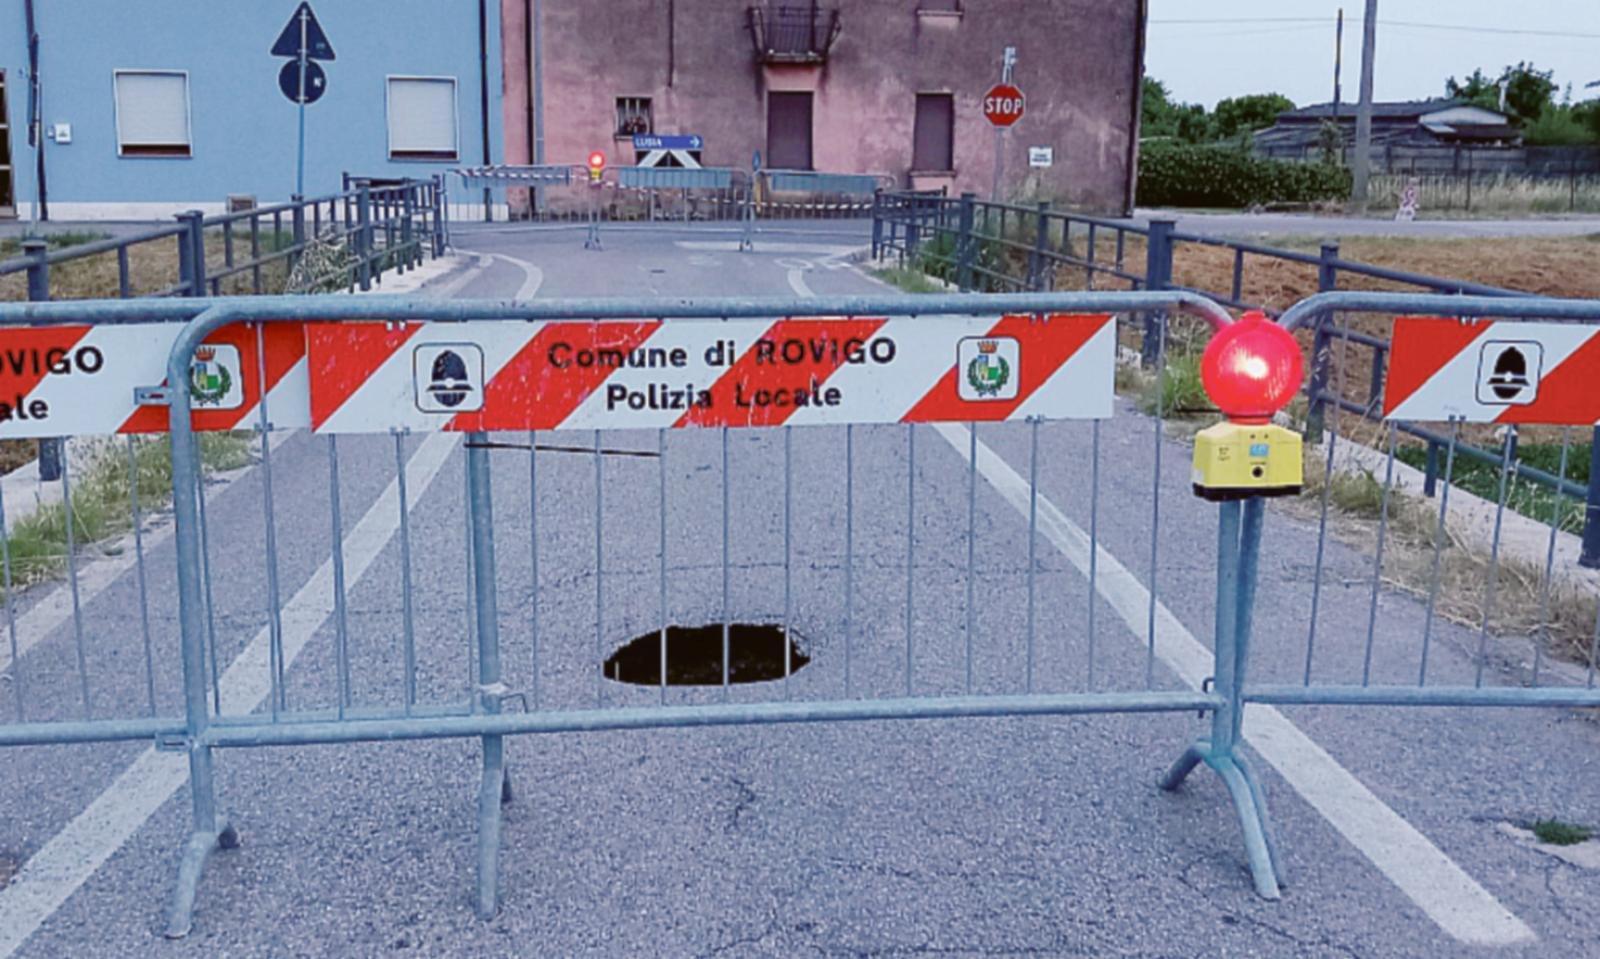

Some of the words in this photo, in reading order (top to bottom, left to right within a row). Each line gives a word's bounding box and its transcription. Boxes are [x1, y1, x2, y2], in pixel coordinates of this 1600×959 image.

[985, 97, 1022, 115] STOP
[0, 345, 104, 375] VIGO
[548, 342, 687, 369] Comune
[704, 340, 736, 366] di
[755, 337, 897, 365] ROVIGO
[607, 383, 713, 411] Polizia
[735, 379, 842, 408] Locale
